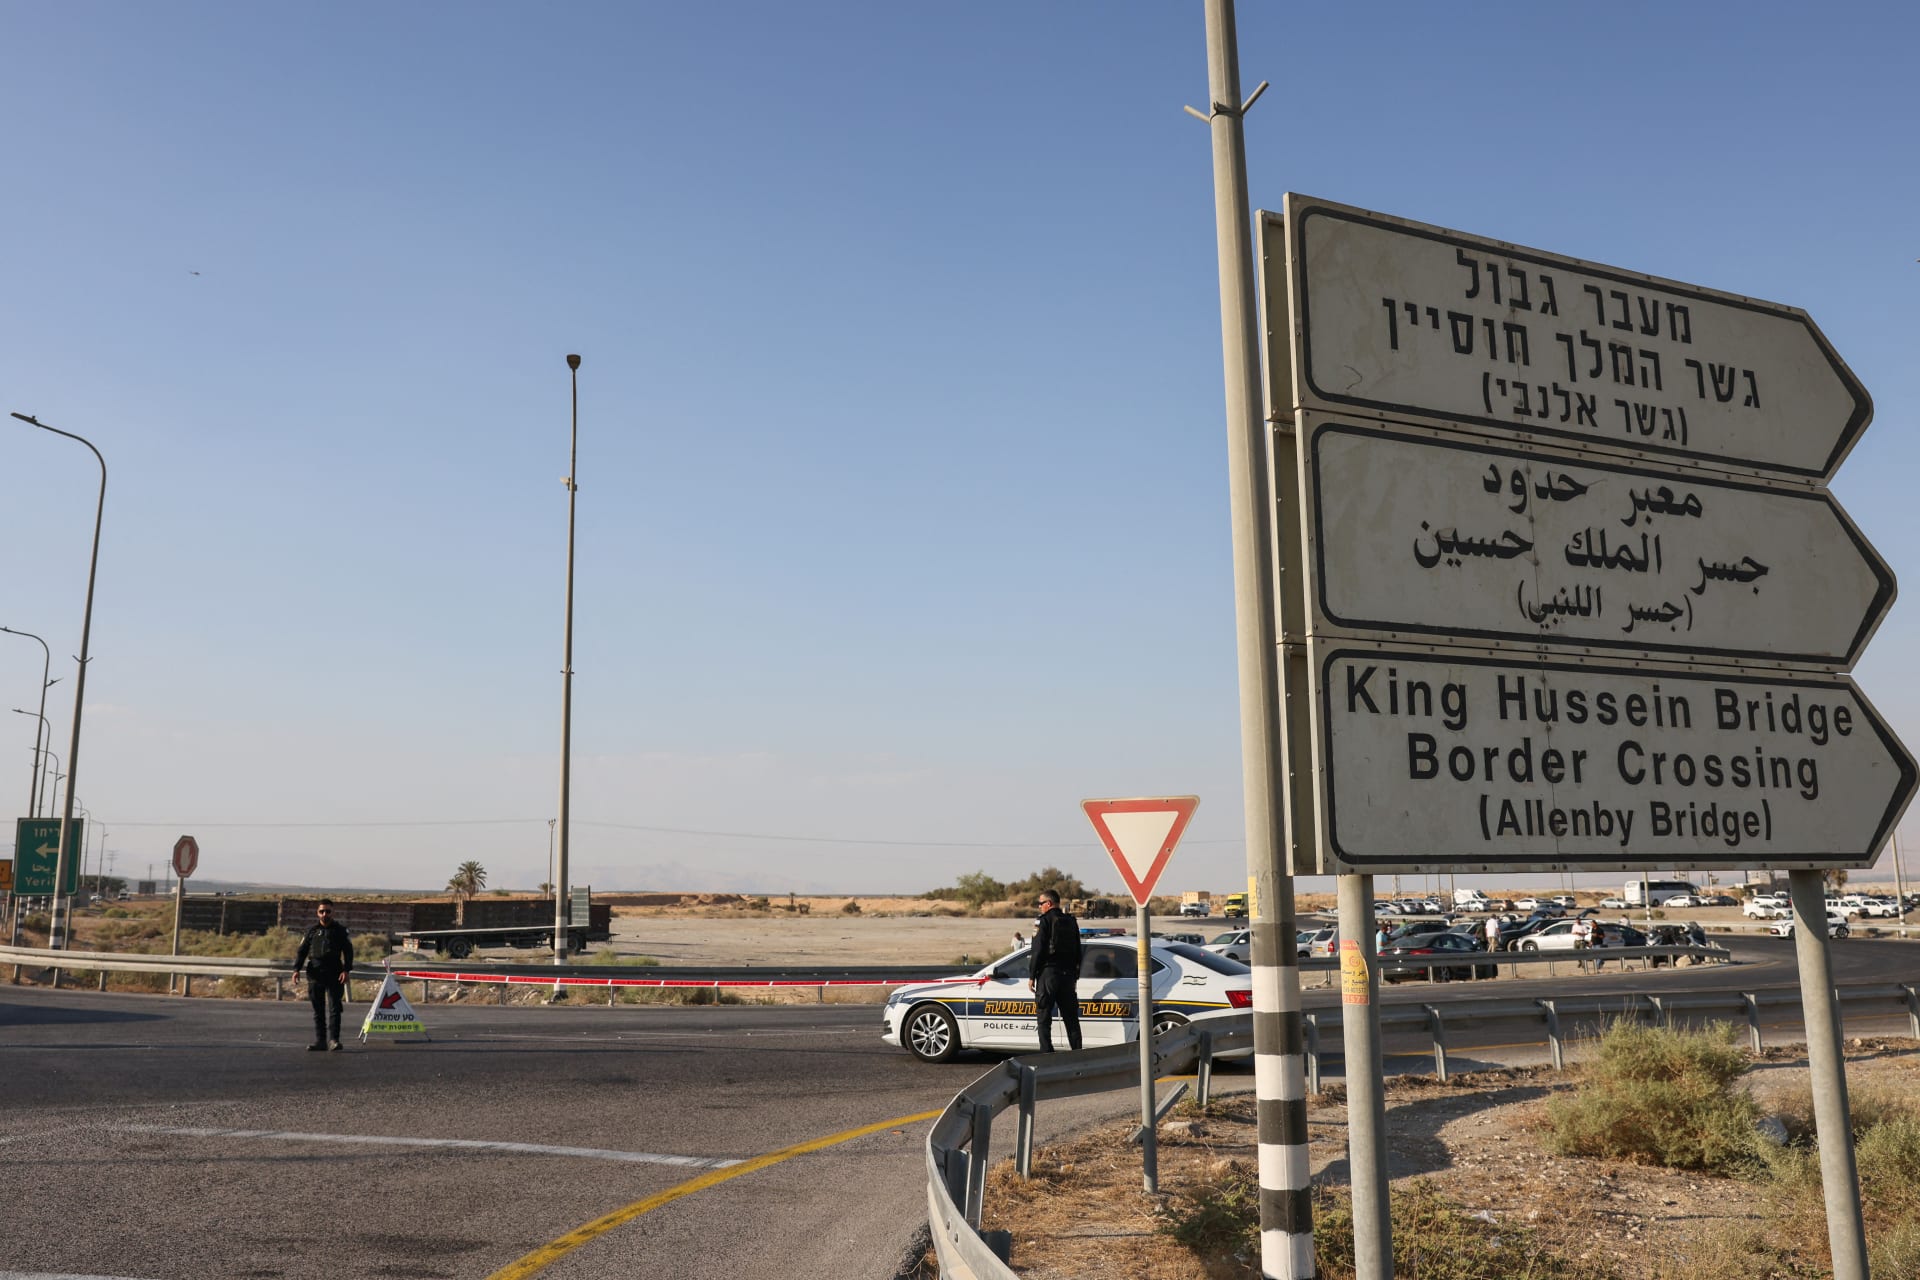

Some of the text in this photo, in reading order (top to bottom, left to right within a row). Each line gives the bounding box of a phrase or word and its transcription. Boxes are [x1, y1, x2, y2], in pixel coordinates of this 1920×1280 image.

[1457, 248, 1693, 345] מעבר גבול
[1382, 297, 1761, 409] גשר המלך חוסיין
[1482, 372, 1688, 447] (גשר אלנבי)
[1482, 463, 1704, 527] معبر حدود
[1413, 520, 1770, 596] جسر الملك حسين
[1517, 579, 1694, 634] (جسر اللنبي)
[1347, 665, 1853, 747] King Hussein Bridge
[1408, 733, 1819, 801] Border Crossing
[1479, 794, 1772, 848] (Allenby Bridge)
[374, 1011, 414, 1021] סע שמאלה
[983, 1022, 1014, 1030] POLICE
[984, 1000, 1132, 1016] משטר תנועה
